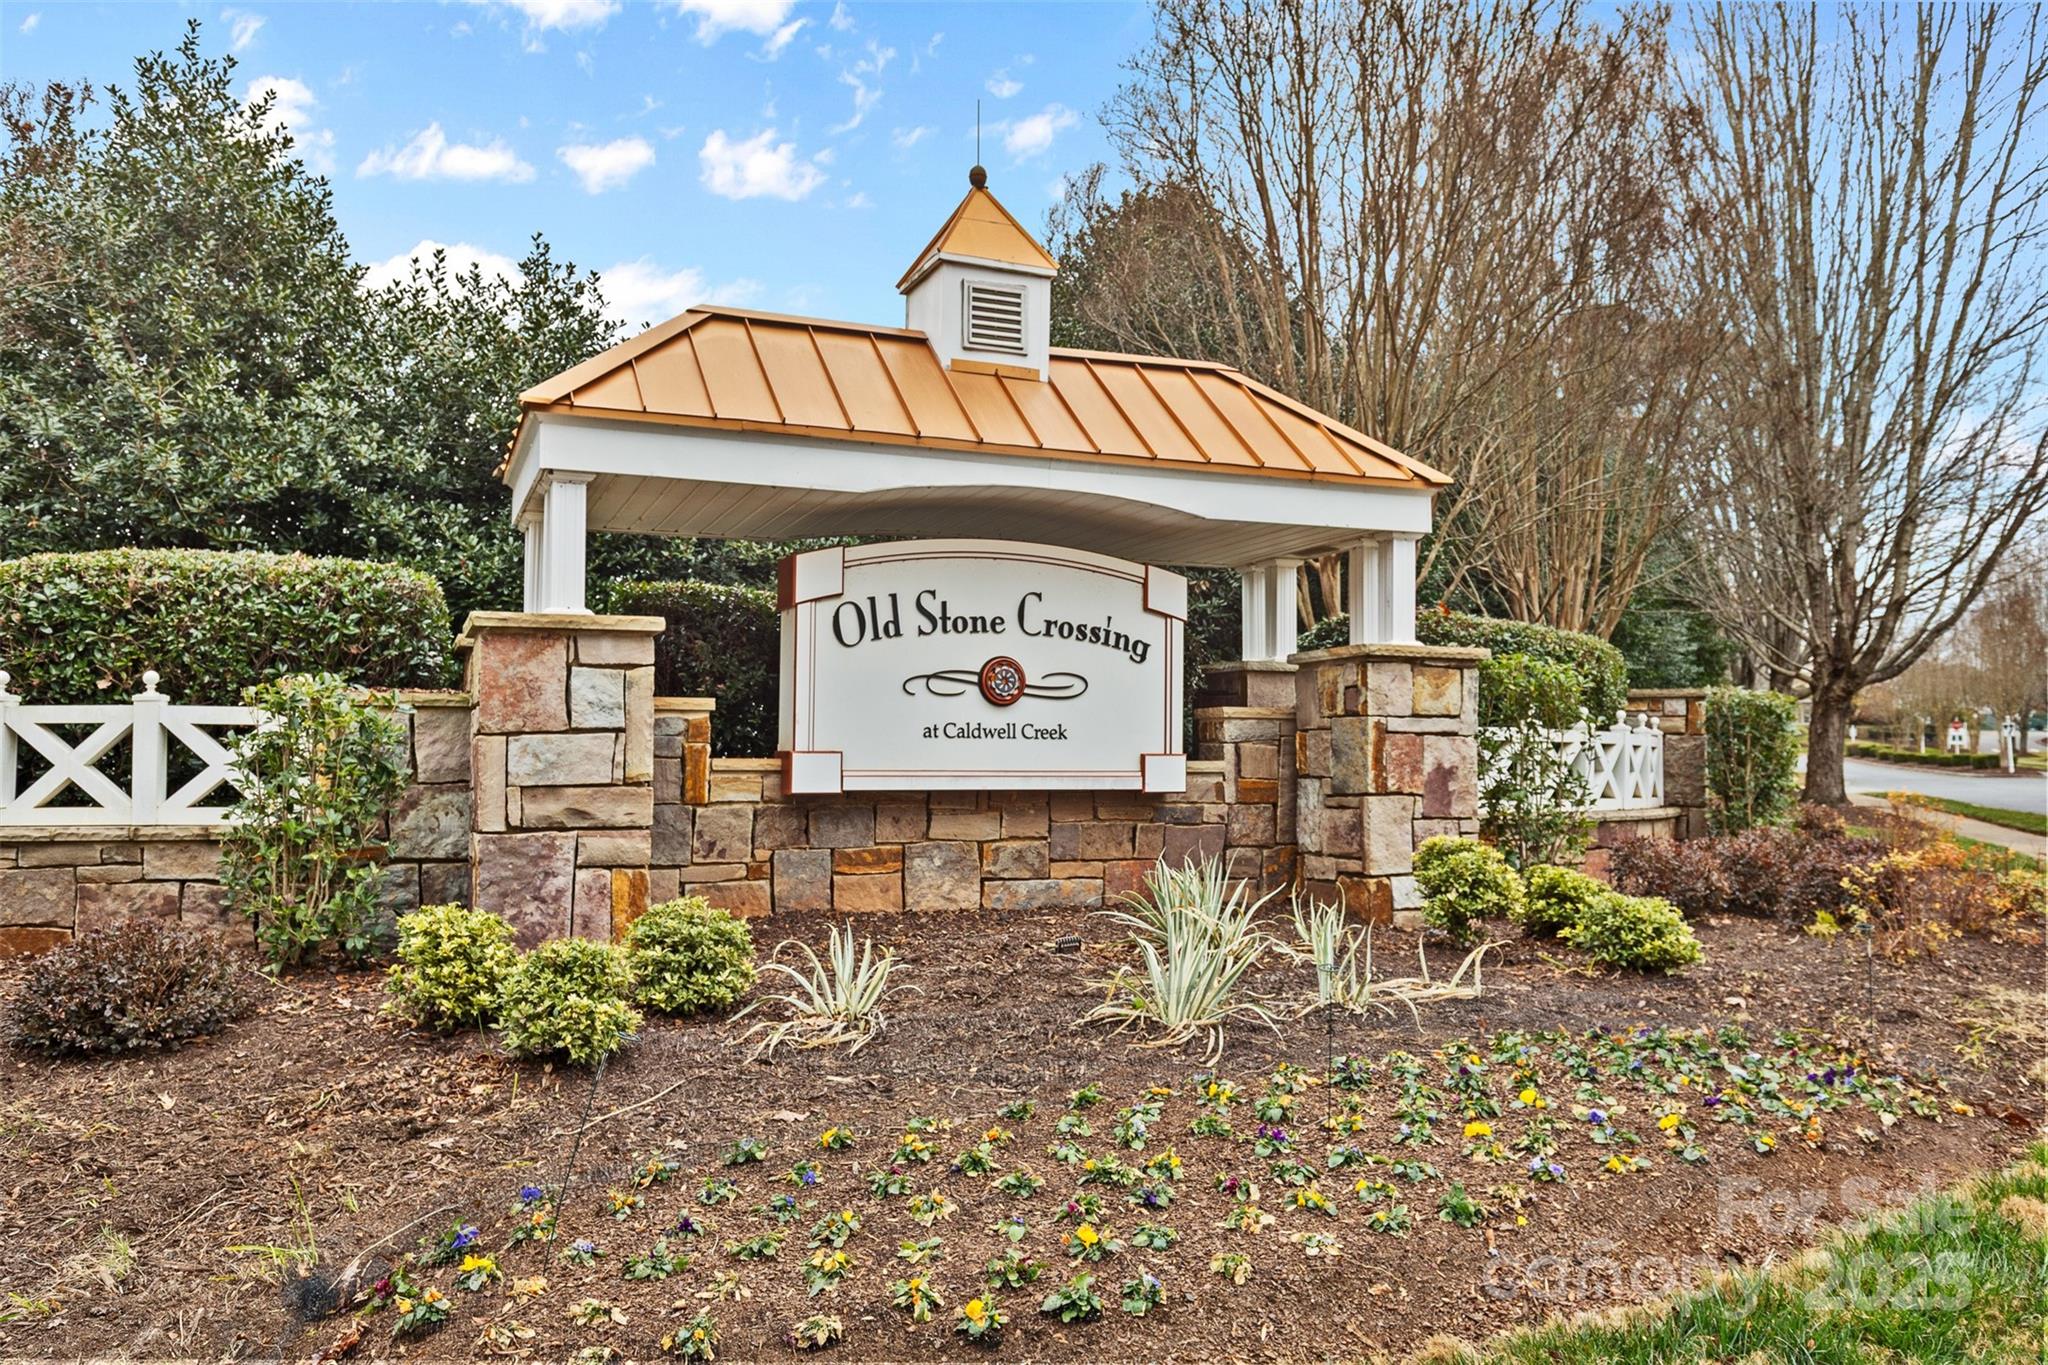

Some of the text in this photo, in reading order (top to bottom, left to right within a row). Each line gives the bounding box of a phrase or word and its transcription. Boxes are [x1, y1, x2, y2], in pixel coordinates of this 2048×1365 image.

[832, 589, 1151, 665] Old Stone Crossing
[922, 722, 1068, 741] at Caldwell Creek
